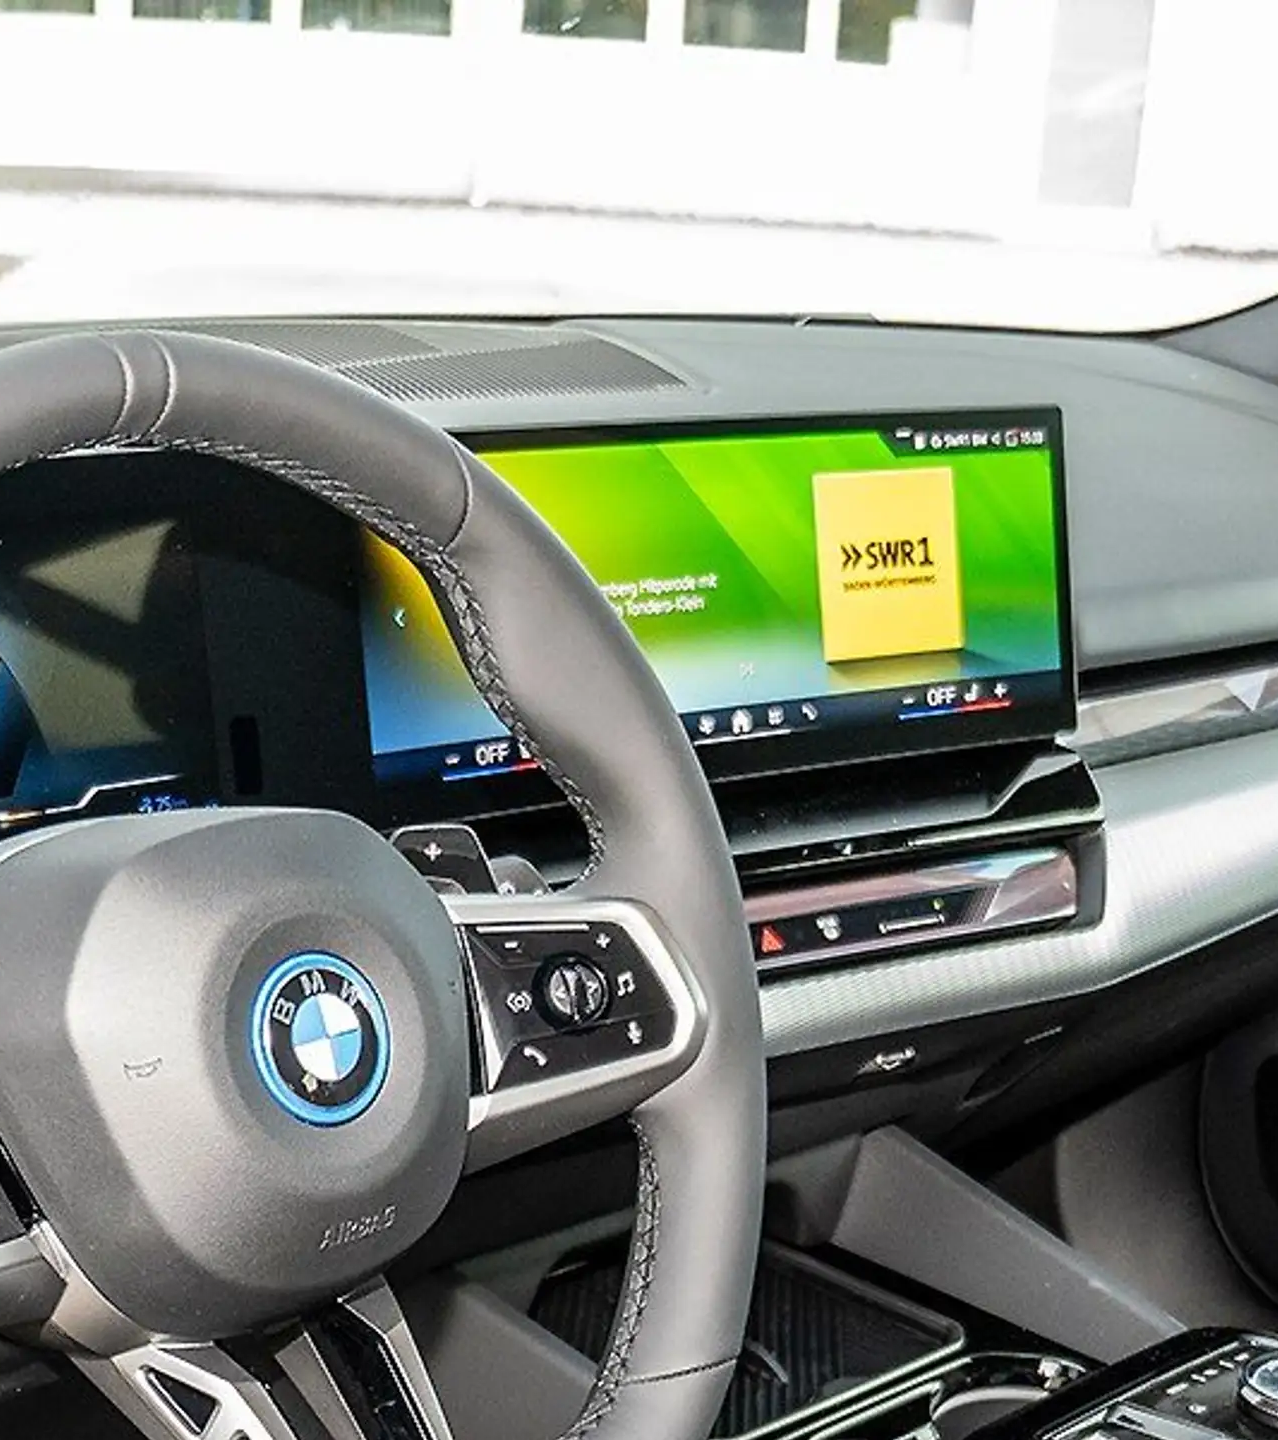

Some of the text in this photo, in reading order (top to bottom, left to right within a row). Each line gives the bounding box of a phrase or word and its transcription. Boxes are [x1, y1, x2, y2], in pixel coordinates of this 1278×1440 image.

[865, 537, 934, 571] SWR1
[926, 685, 957, 706] OFF
[475, 742, 510, 766] OFF
[272, 968, 361, 1026] BMW
